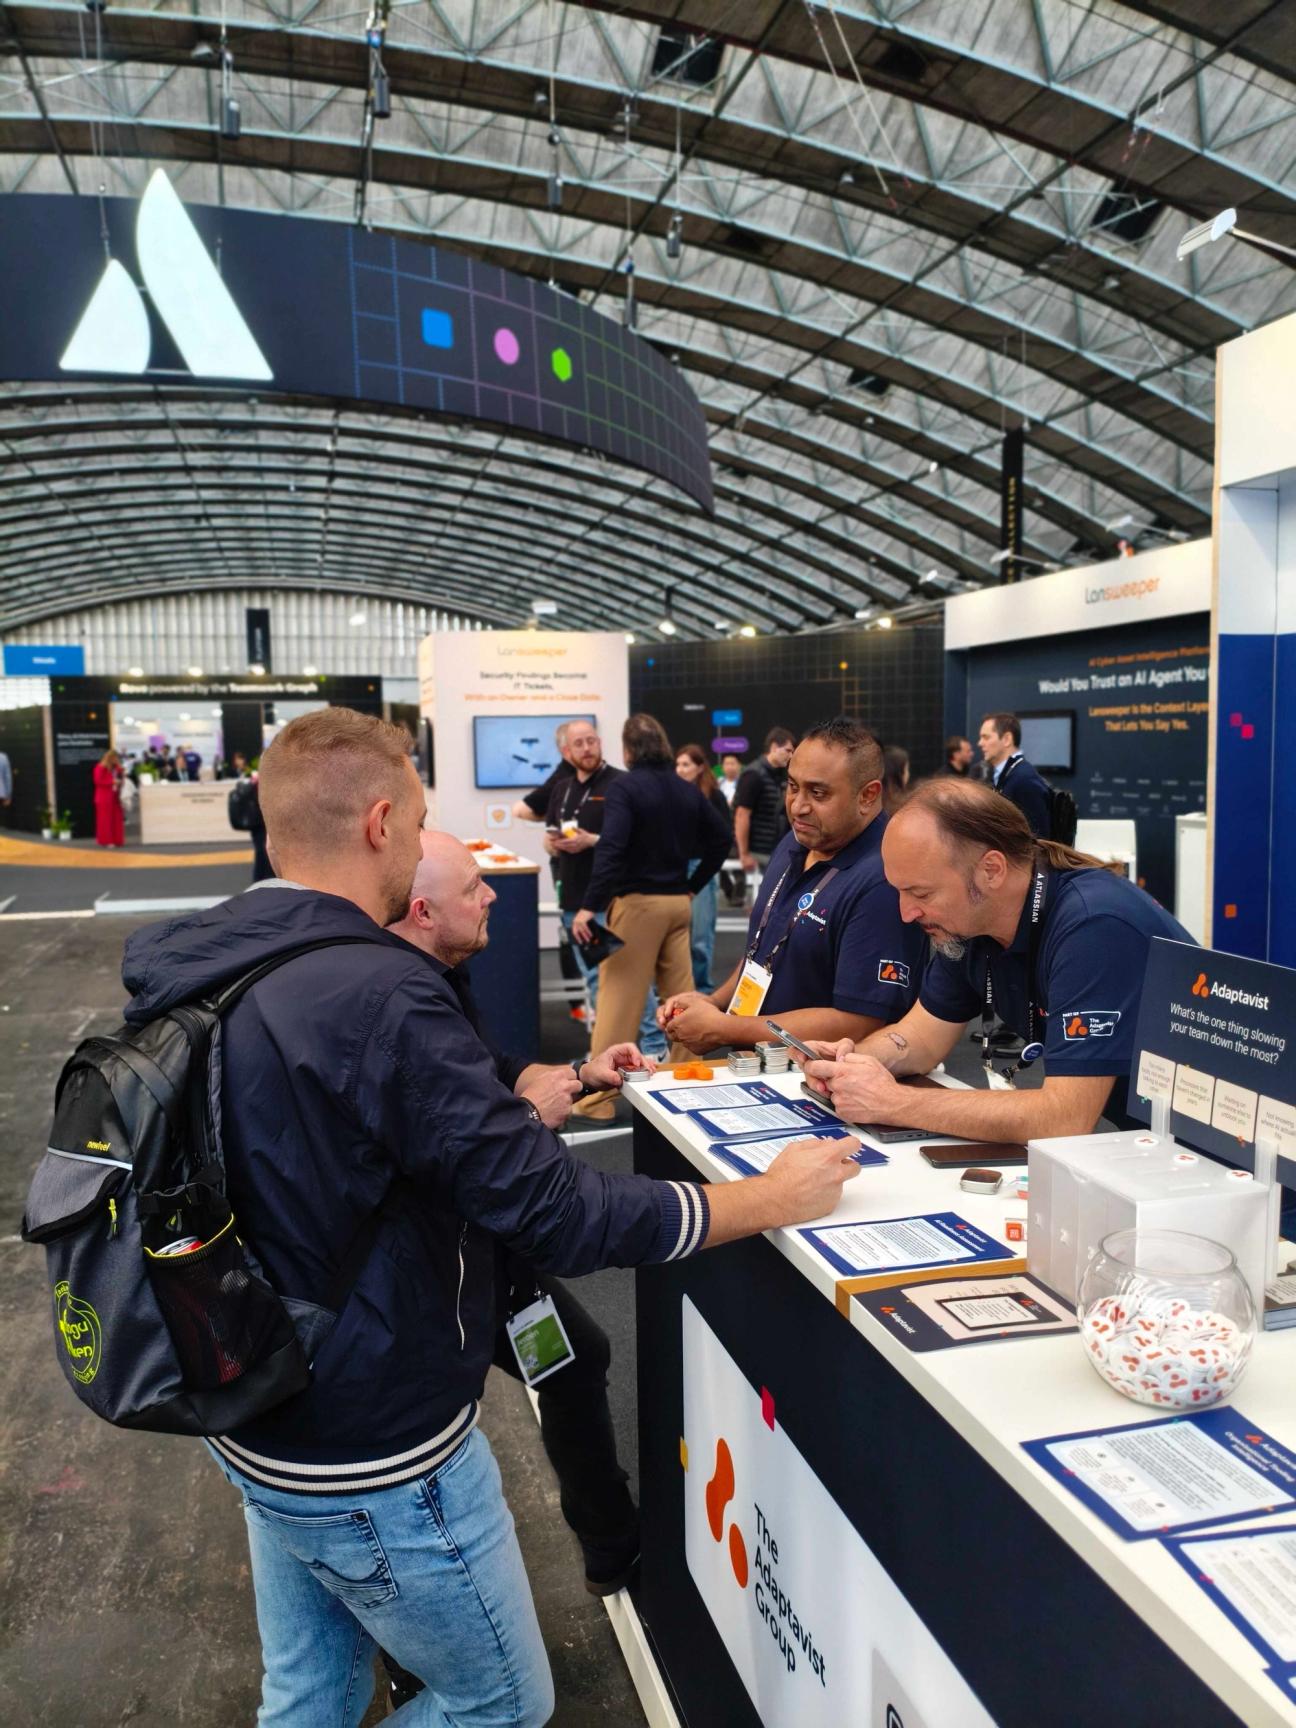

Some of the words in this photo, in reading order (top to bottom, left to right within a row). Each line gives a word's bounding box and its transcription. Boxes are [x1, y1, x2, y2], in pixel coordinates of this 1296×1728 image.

[1085, 577, 1161, 604] Lansweeper
[1038, 678, 1070, 694] Would
[1071, 677, 1089, 692] You
[1091, 674, 1116, 689] Trust
[1118, 674, 1133, 687] an
[1134, 669, 1147, 685] AI
[1148, 667, 1183, 688] Agent
[1184, 665, 1206, 681] You
[1031, 880, 1043, 923] ATLASSIAN
[1210, 981, 1270, 1010] Adaptavist
[1170, 1002, 1196, 1020] What's
[1197, 1010, 1210, 1024] the
[1211, 1018, 1226, 1030] one
[1228, 1020, 1249, 1040] thing
[1250, 1028, 1286, 1051] slowing
[1170, 1021, 1187, 1034] your
[1189, 1026, 1209, 1041] team
[1211, 1033, 1234, 1050] down
[1235, 1041, 1249, 1055] the
[1250, 1048, 1279, 1065] most?
[754, 1502, 778, 1565] The
[755, 1545, 826, 1688] Adaptavist
[755, 1582, 796, 1672] Group
